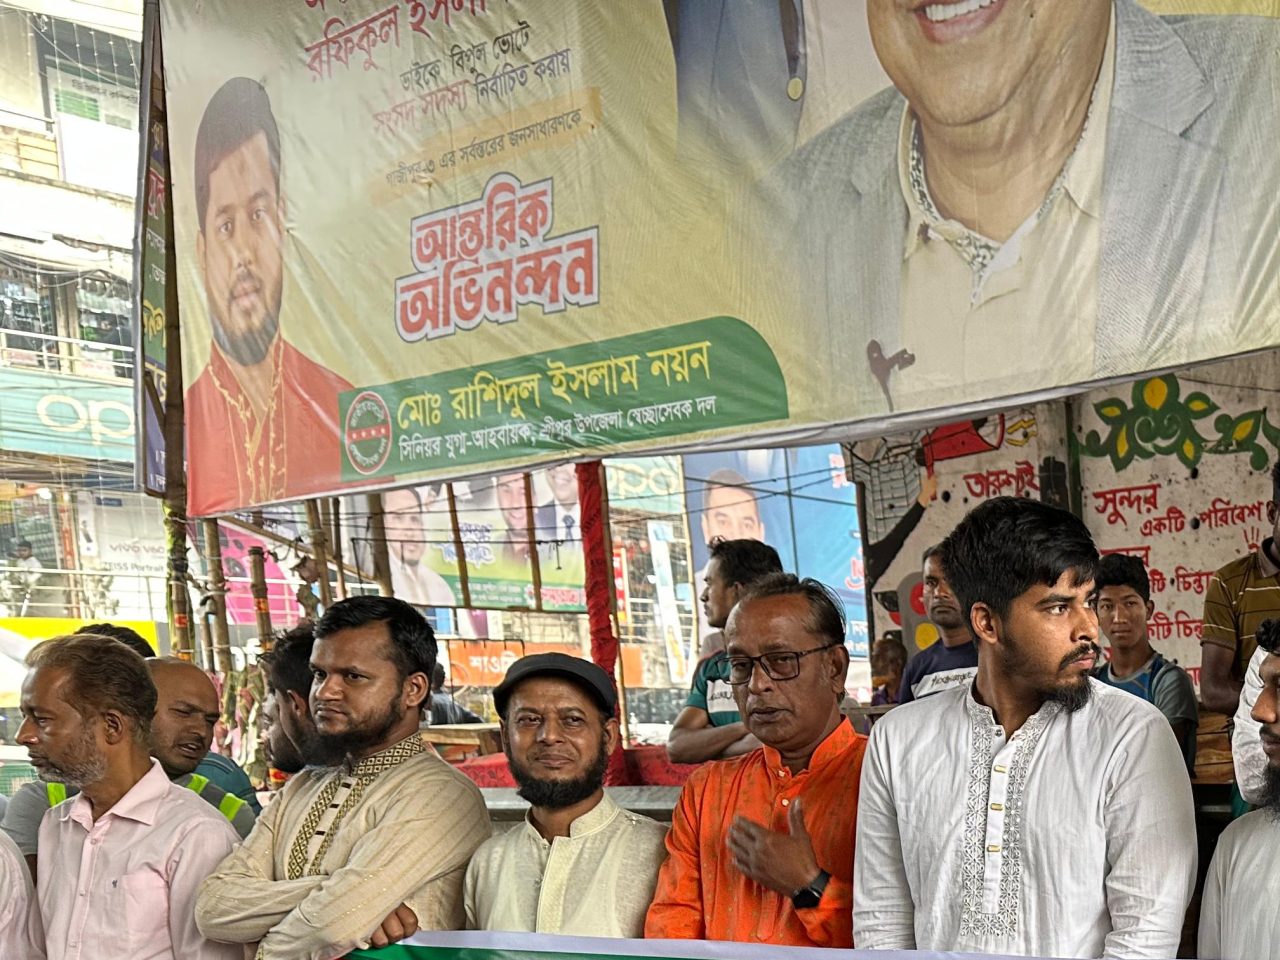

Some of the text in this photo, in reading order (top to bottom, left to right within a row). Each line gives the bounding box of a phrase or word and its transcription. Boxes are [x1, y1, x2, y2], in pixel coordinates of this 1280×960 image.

[304, 5, 400, 82] রফিকুল
[450, 41, 488, 76] বিপুল
[492, 22, 530, 56] ভোটে
[475, 63, 529, 105] নির্বাচিত
[532, 49, 571, 81] করায়
[439, 150, 456, 170] এর
[459, 135, 506, 163] সর্বস্তরের
[507, 109, 582, 147] জনসাধারণকে
[415, 181, 548, 264] আন্তরিক
[400, 238, 594, 334] অভিনন্দন
[396, 390, 443, 430] মোঃ
[448, 370, 541, 420] রাশিদুল
[546, 354, 641, 404] ইসলাম
[646, 340, 712, 388] নয়ন
[398, 431, 441, 462] সিনিয়র
[573, 409, 623, 433] উপজেলা
[626, 399, 693, 427] স্বেচ্ছাসেবক
[695, 395, 717, 417] দল
[1092, 484, 1161, 526] সুন্দর
[1140, 498, 1264, 536] একটি পরিবেশ
